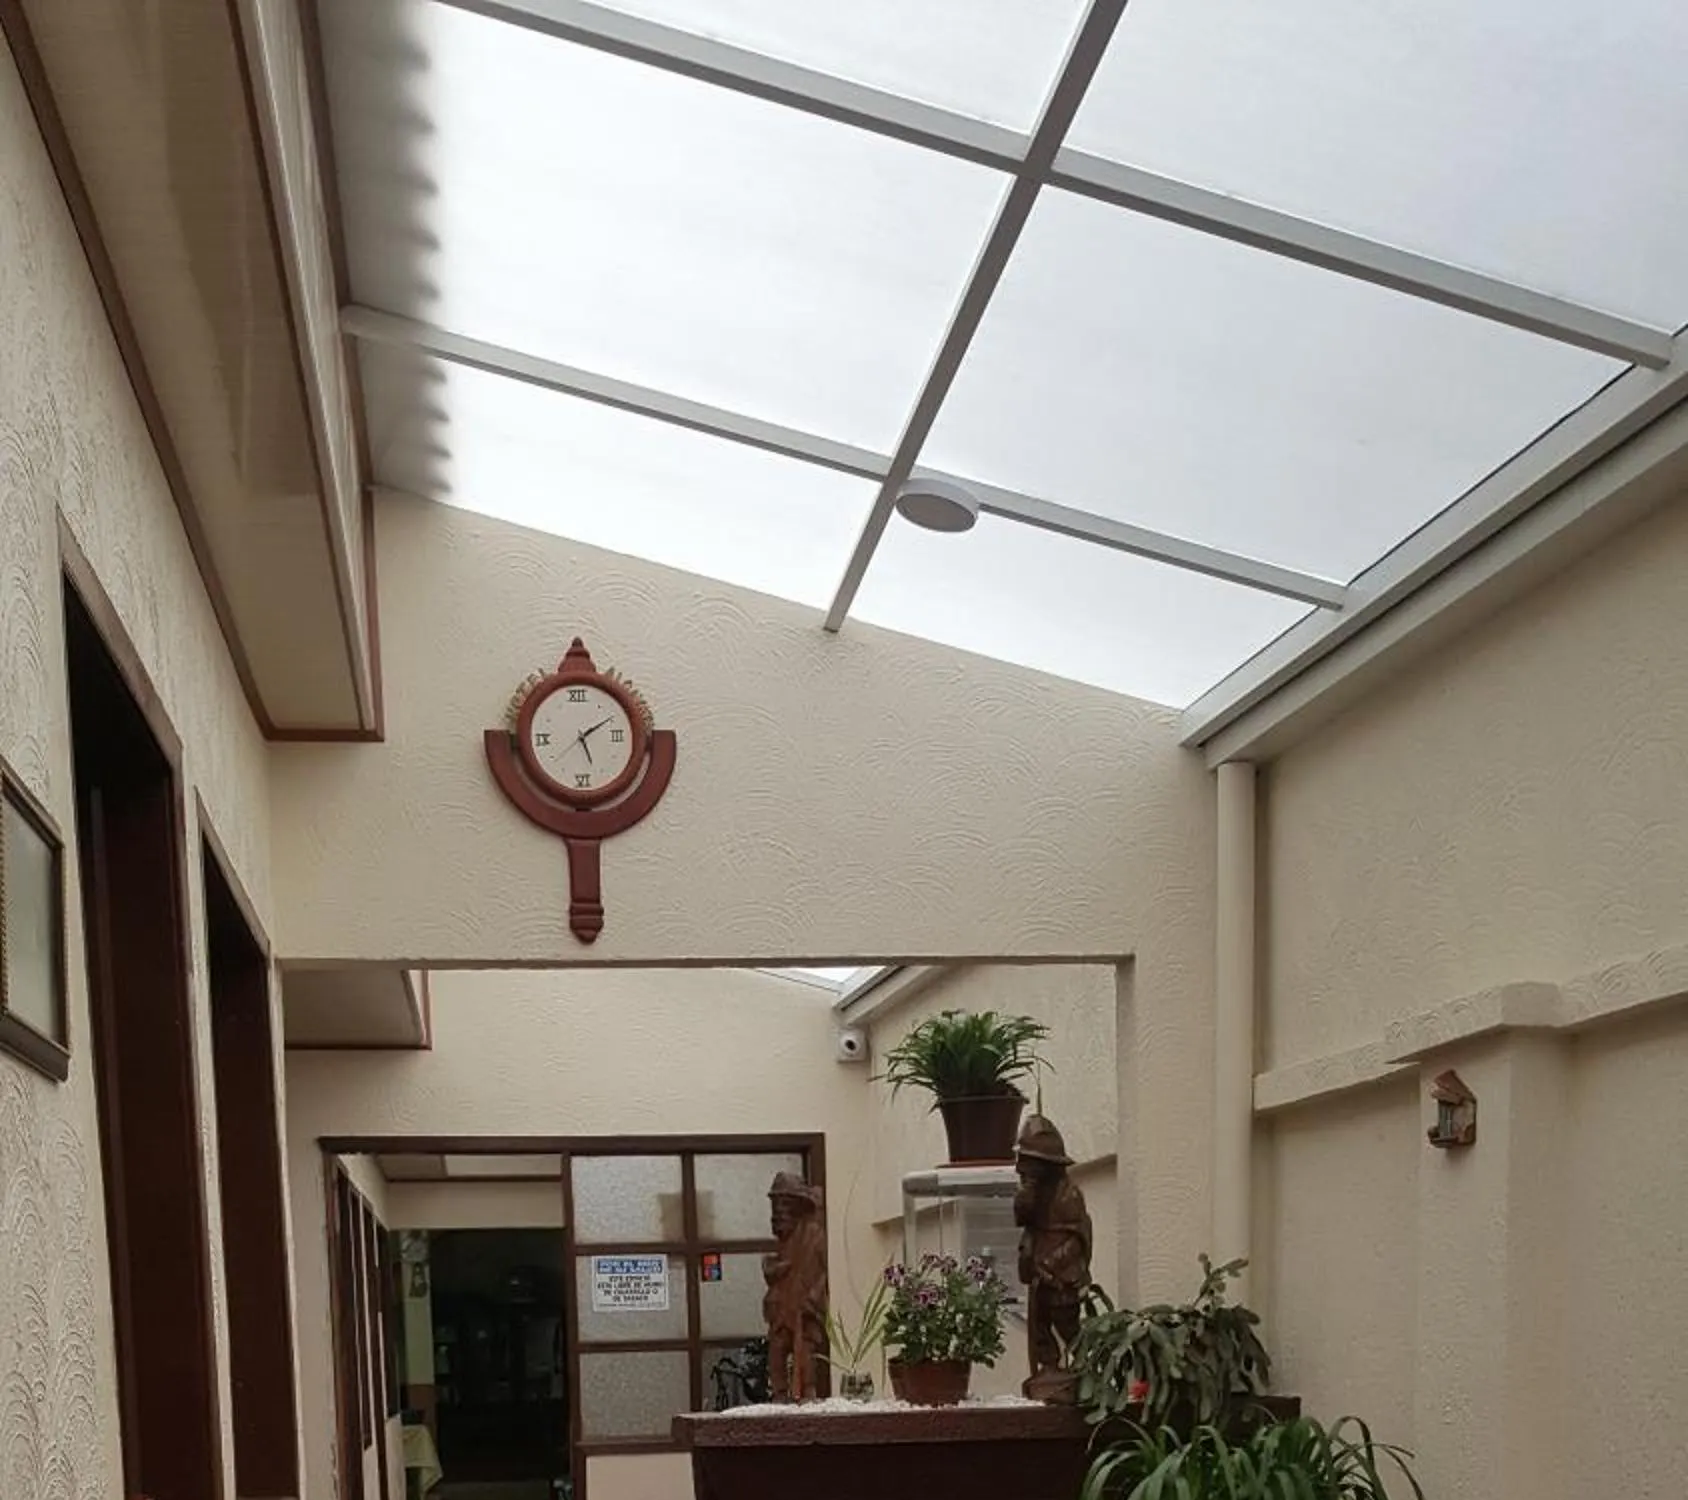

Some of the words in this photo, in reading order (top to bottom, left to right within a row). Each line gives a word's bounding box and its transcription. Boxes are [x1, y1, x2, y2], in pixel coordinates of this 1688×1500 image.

[567, 689, 588, 702] XII
[535, 733, 551, 746] IX
[609, 729, 624, 742] III
[575, 774, 591, 787] VI
